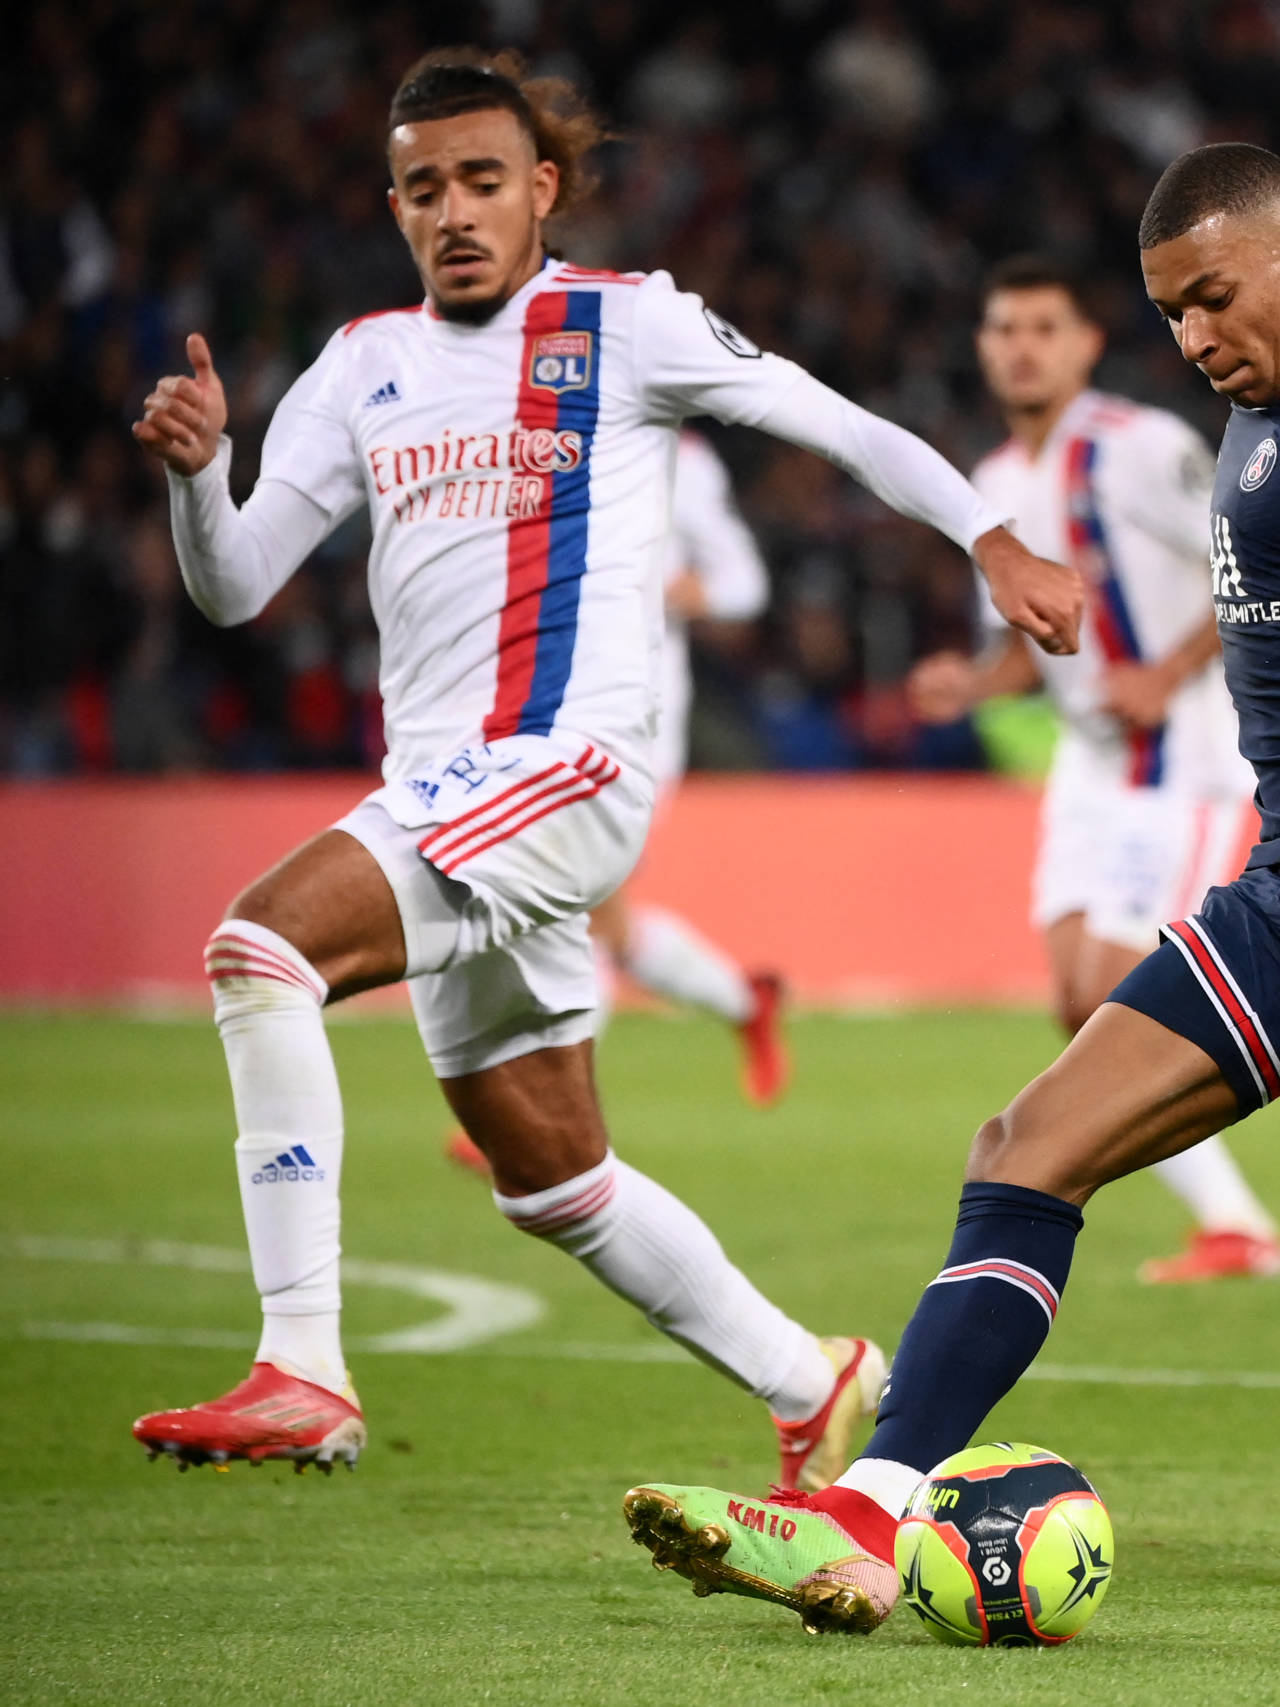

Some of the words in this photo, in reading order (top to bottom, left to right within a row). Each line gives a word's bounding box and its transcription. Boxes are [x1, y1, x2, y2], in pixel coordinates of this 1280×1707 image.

[535, 357, 583, 383] OL
[369, 419, 583, 496] Emirates
[438, 475, 545, 520] BETTER
[251, 1166, 326, 1185] adidas
[726, 1499, 797, 1542] KM10
